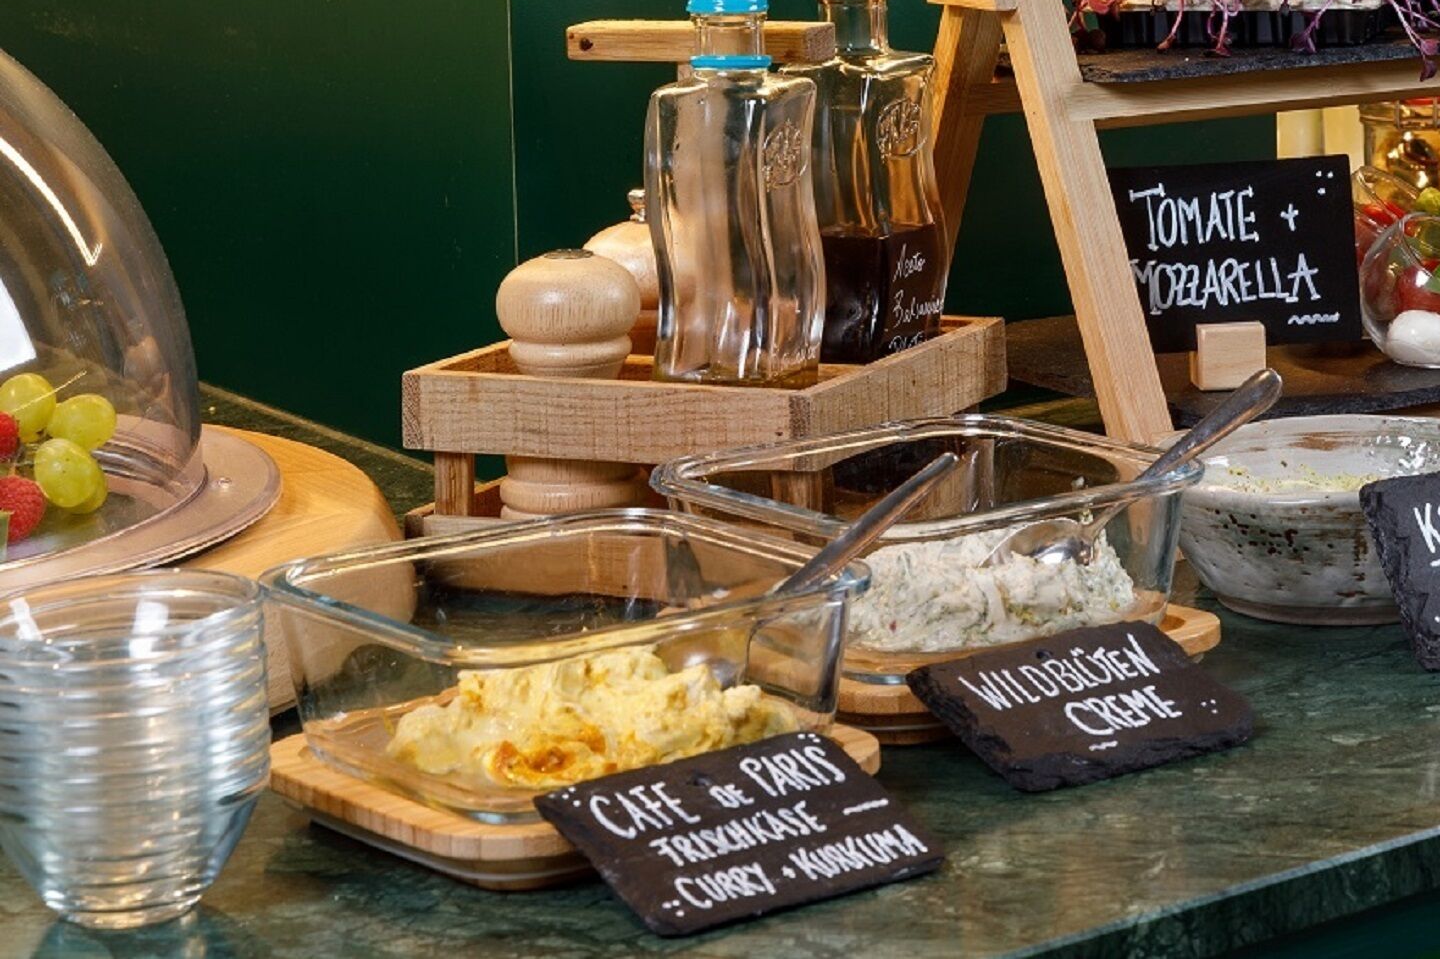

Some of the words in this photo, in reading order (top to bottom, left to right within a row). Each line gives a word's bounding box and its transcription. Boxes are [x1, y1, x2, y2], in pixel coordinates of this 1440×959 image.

[1128, 182, 1260, 252] TOMATE
[1280, 201, 1300, 232] +
[1128, 252, 1322, 316] MOZZARELLA
[958, 633, 1162, 712] WILDBLÜTEN
[1063, 684, 1183, 737] CREME
[588, 780, 702, 841] CAFE
[707, 783, 756, 811] DE
[738, 745, 847, 798] PARIS
[648, 800, 828, 869] FRISCHKÄSE
[675, 862, 778, 910] CURRY
[790, 824, 930, 882] KURKUMA
